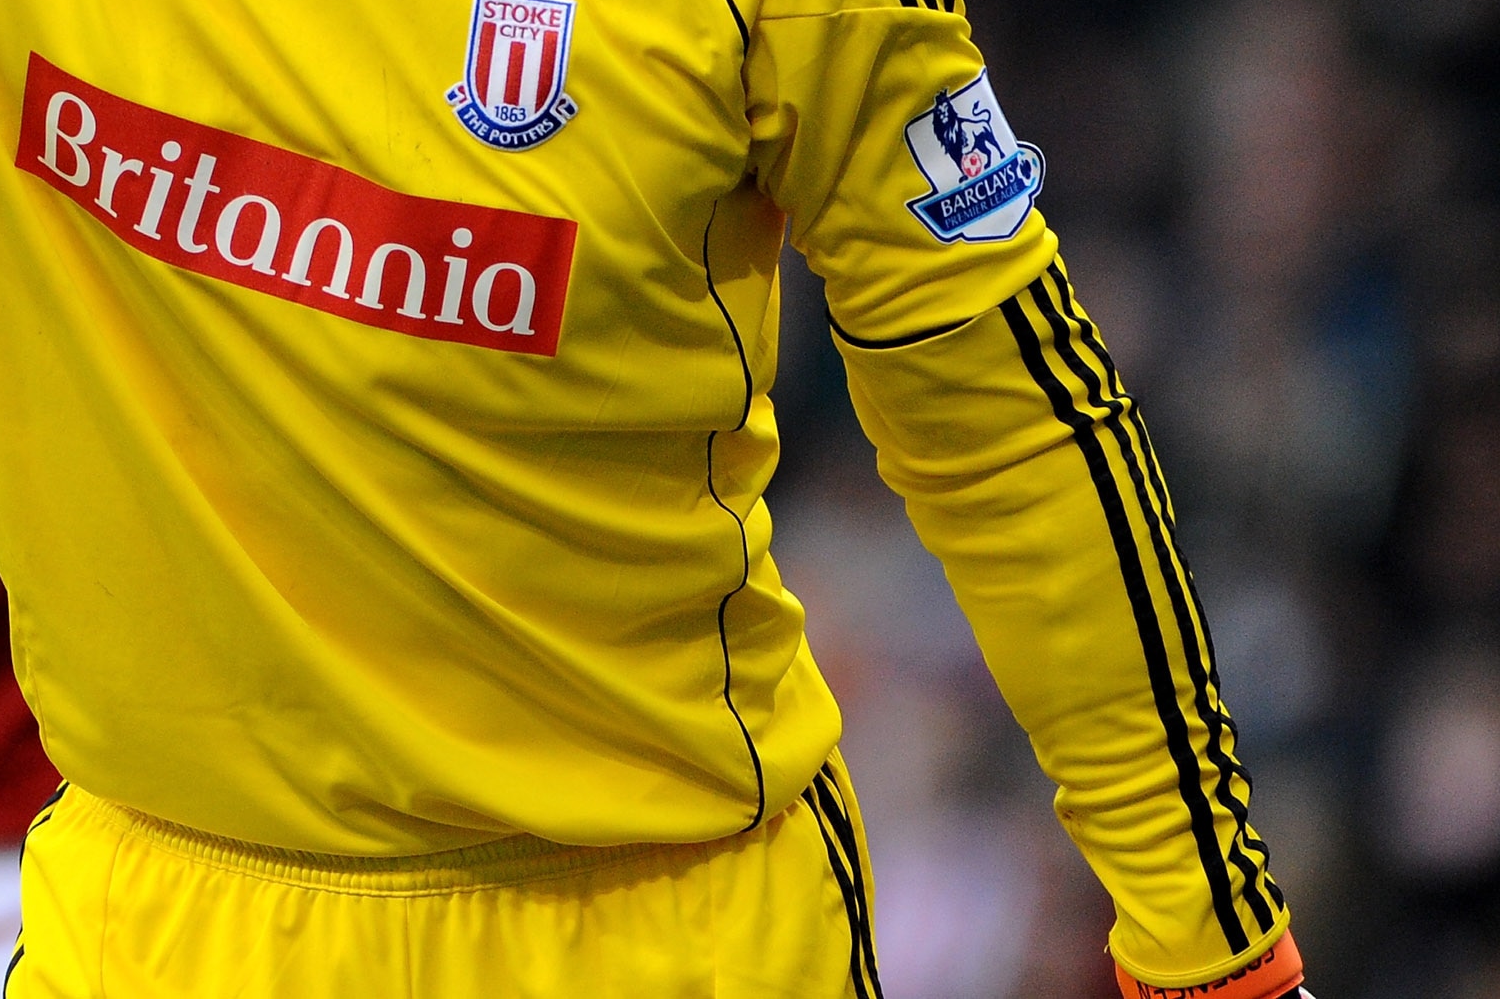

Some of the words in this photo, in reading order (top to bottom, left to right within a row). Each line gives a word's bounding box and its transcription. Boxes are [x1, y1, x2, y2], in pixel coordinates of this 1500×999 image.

[484, 1, 563, 28] STOKE
[500, 24, 540, 41] CITY
[463, 108, 489, 137] THE
[489, 118, 554, 145] POTTERS
[494, 106, 527, 122] 1863
[940, 164, 1016, 218] BARCLAYS
[944, 201, 989, 229] PREMIER
[989, 182, 1019, 207] LEAGUE
[37, 91, 536, 336] Britannia
